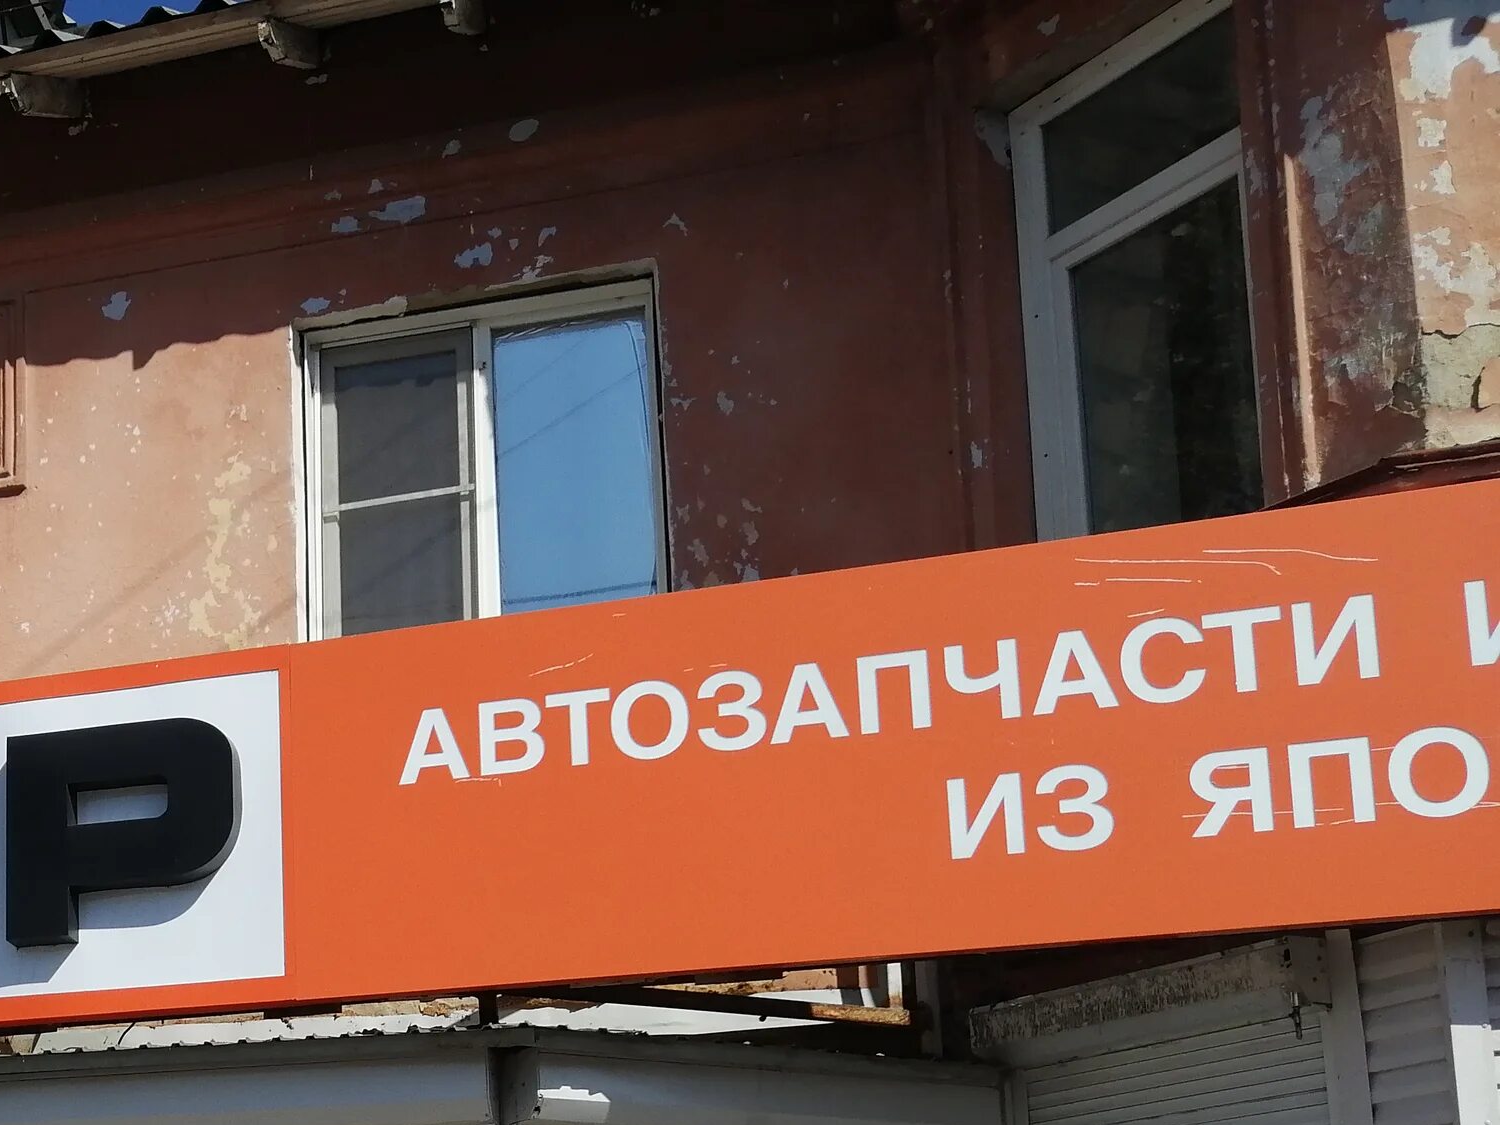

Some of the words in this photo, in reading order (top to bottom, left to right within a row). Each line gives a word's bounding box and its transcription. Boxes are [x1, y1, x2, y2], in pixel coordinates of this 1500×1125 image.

[399, 593, 1381, 786] АВТОЗАПЧАСТИ
[946, 764, 1113, 859] ИЗ
[1188, 726, 1490, 838] ЯПО
